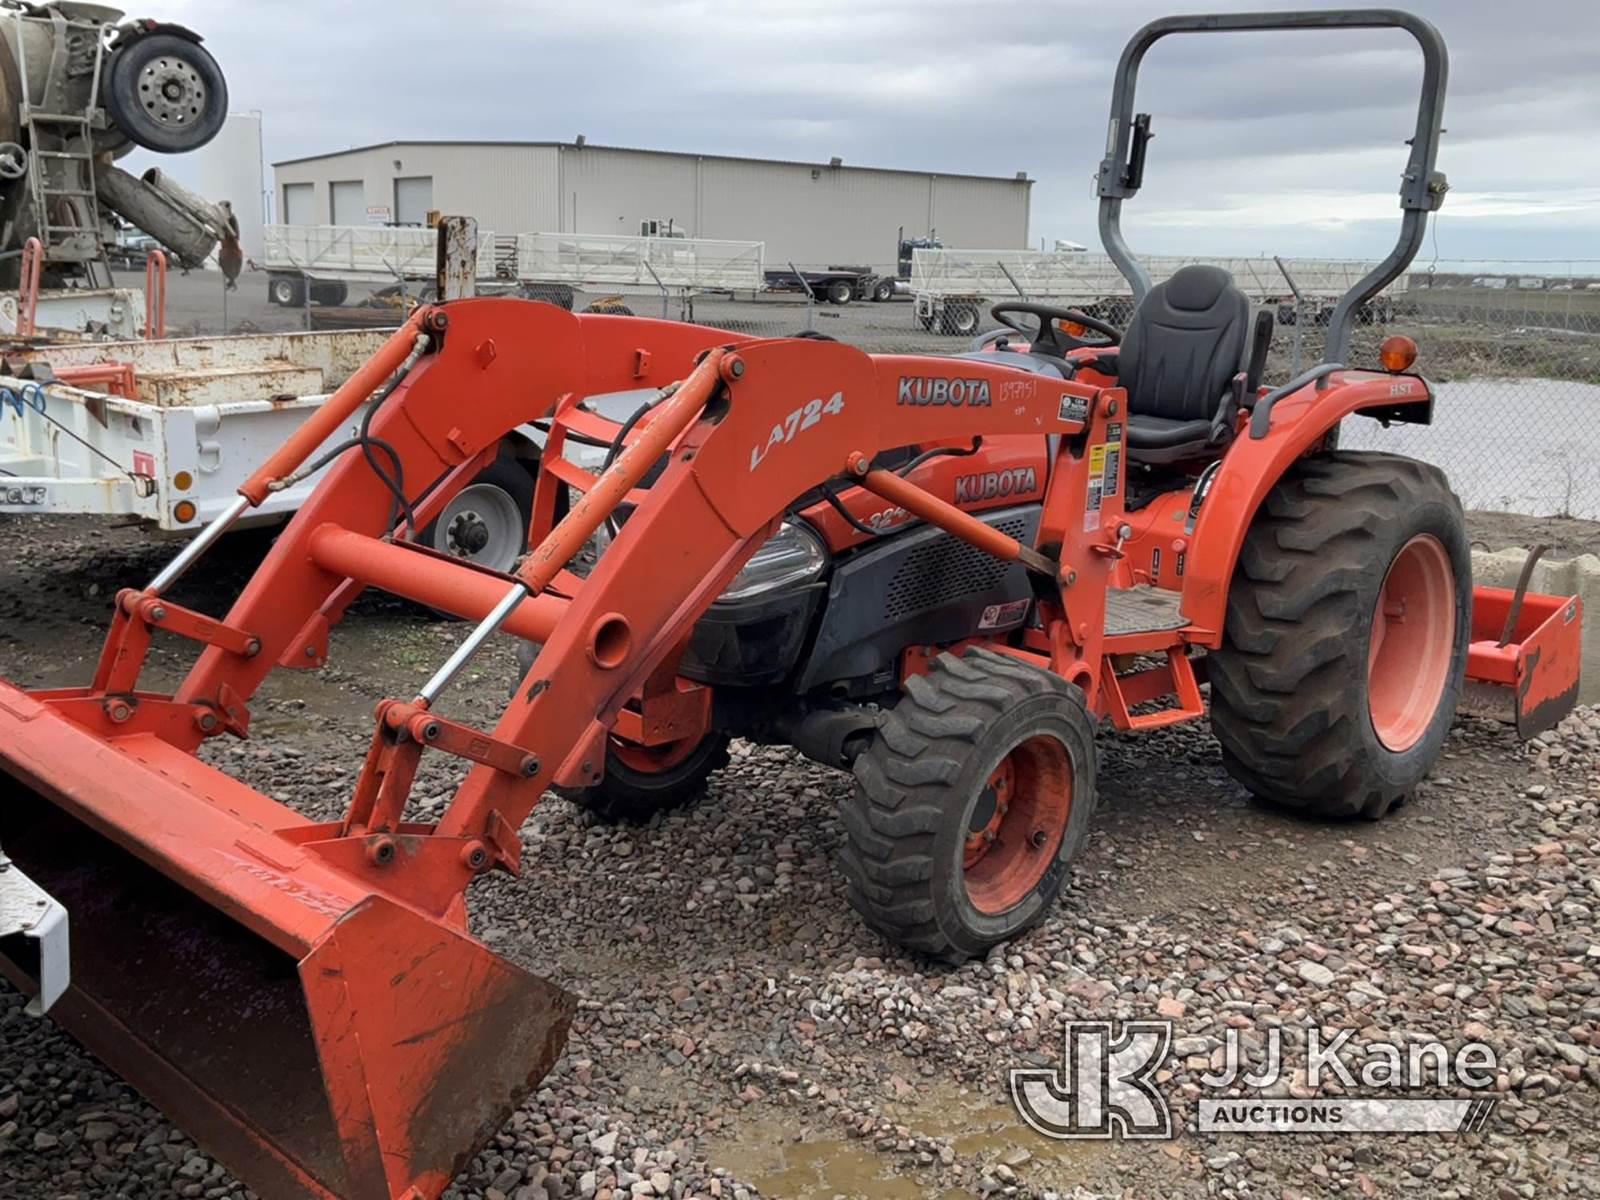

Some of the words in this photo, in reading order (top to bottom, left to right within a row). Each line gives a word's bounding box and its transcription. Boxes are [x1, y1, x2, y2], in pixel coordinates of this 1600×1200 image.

[897, 376, 992, 406] KUBOTA
[1391, 382, 1414, 396] HST
[750, 391, 845, 472] LA724
[955, 466, 1036, 502] KUBOTA
